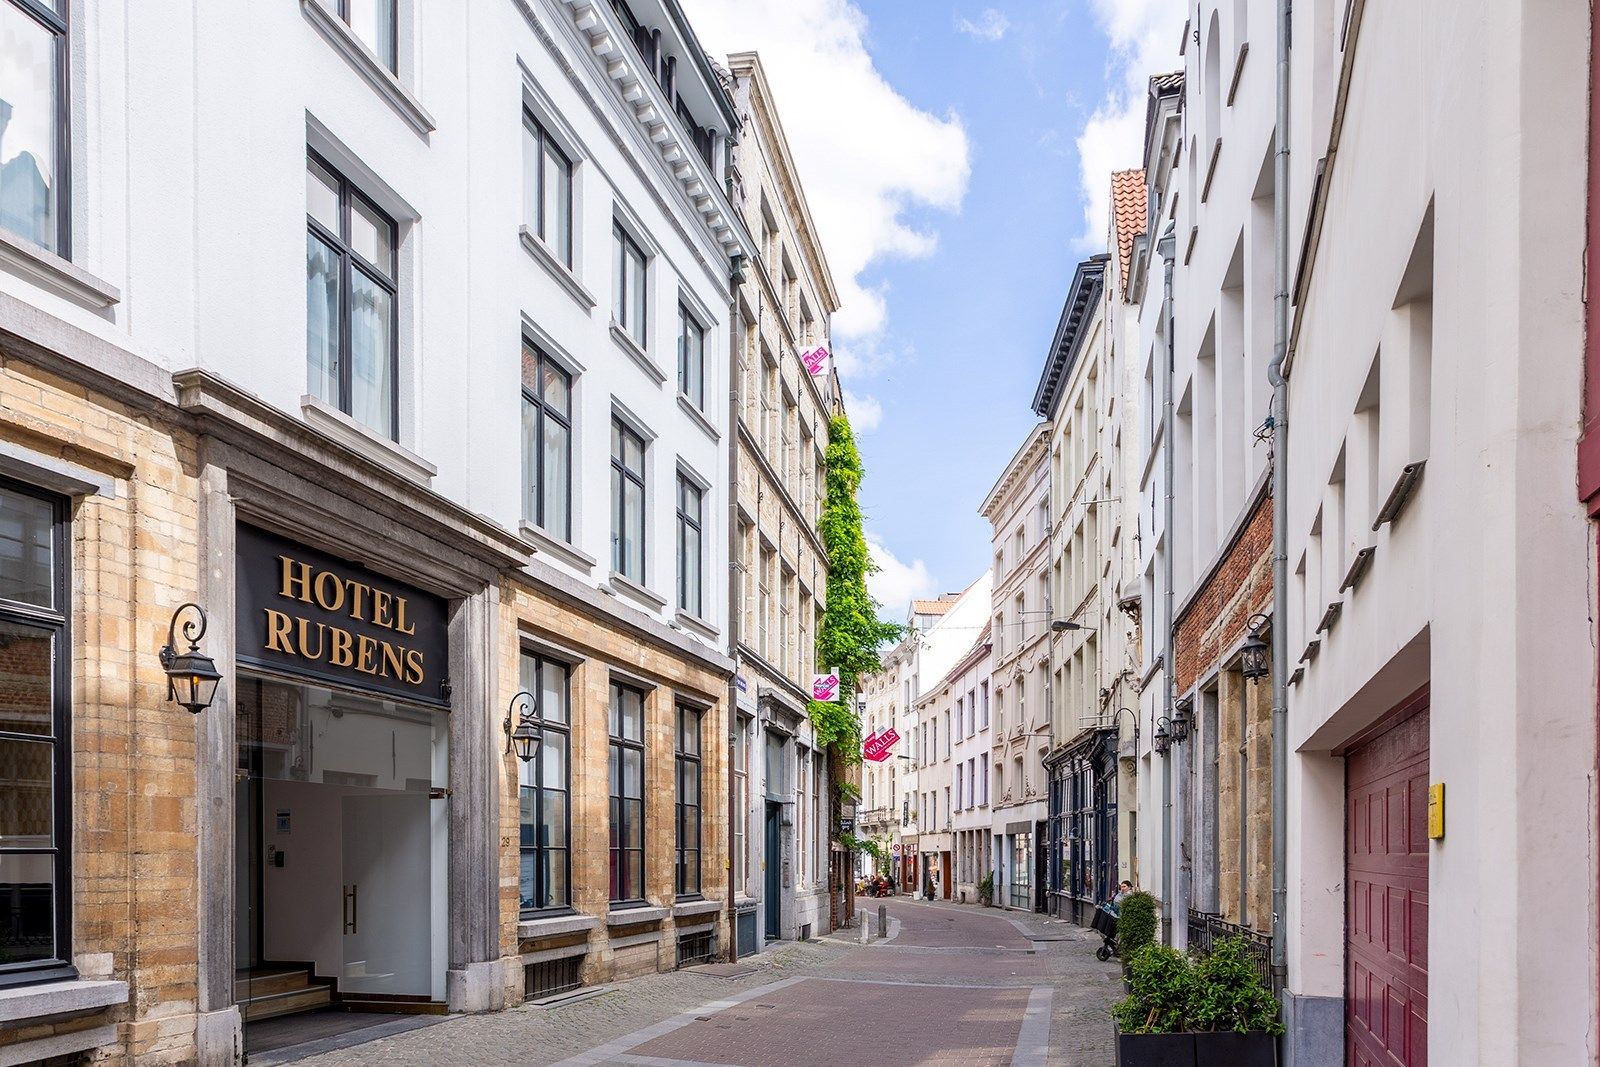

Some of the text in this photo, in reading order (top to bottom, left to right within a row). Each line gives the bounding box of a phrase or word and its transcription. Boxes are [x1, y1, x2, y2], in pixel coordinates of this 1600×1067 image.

[278, 554, 416, 636] HOTEL
[264, 607, 425, 685] RUBENS
[865, 730, 896, 755] WALLS
